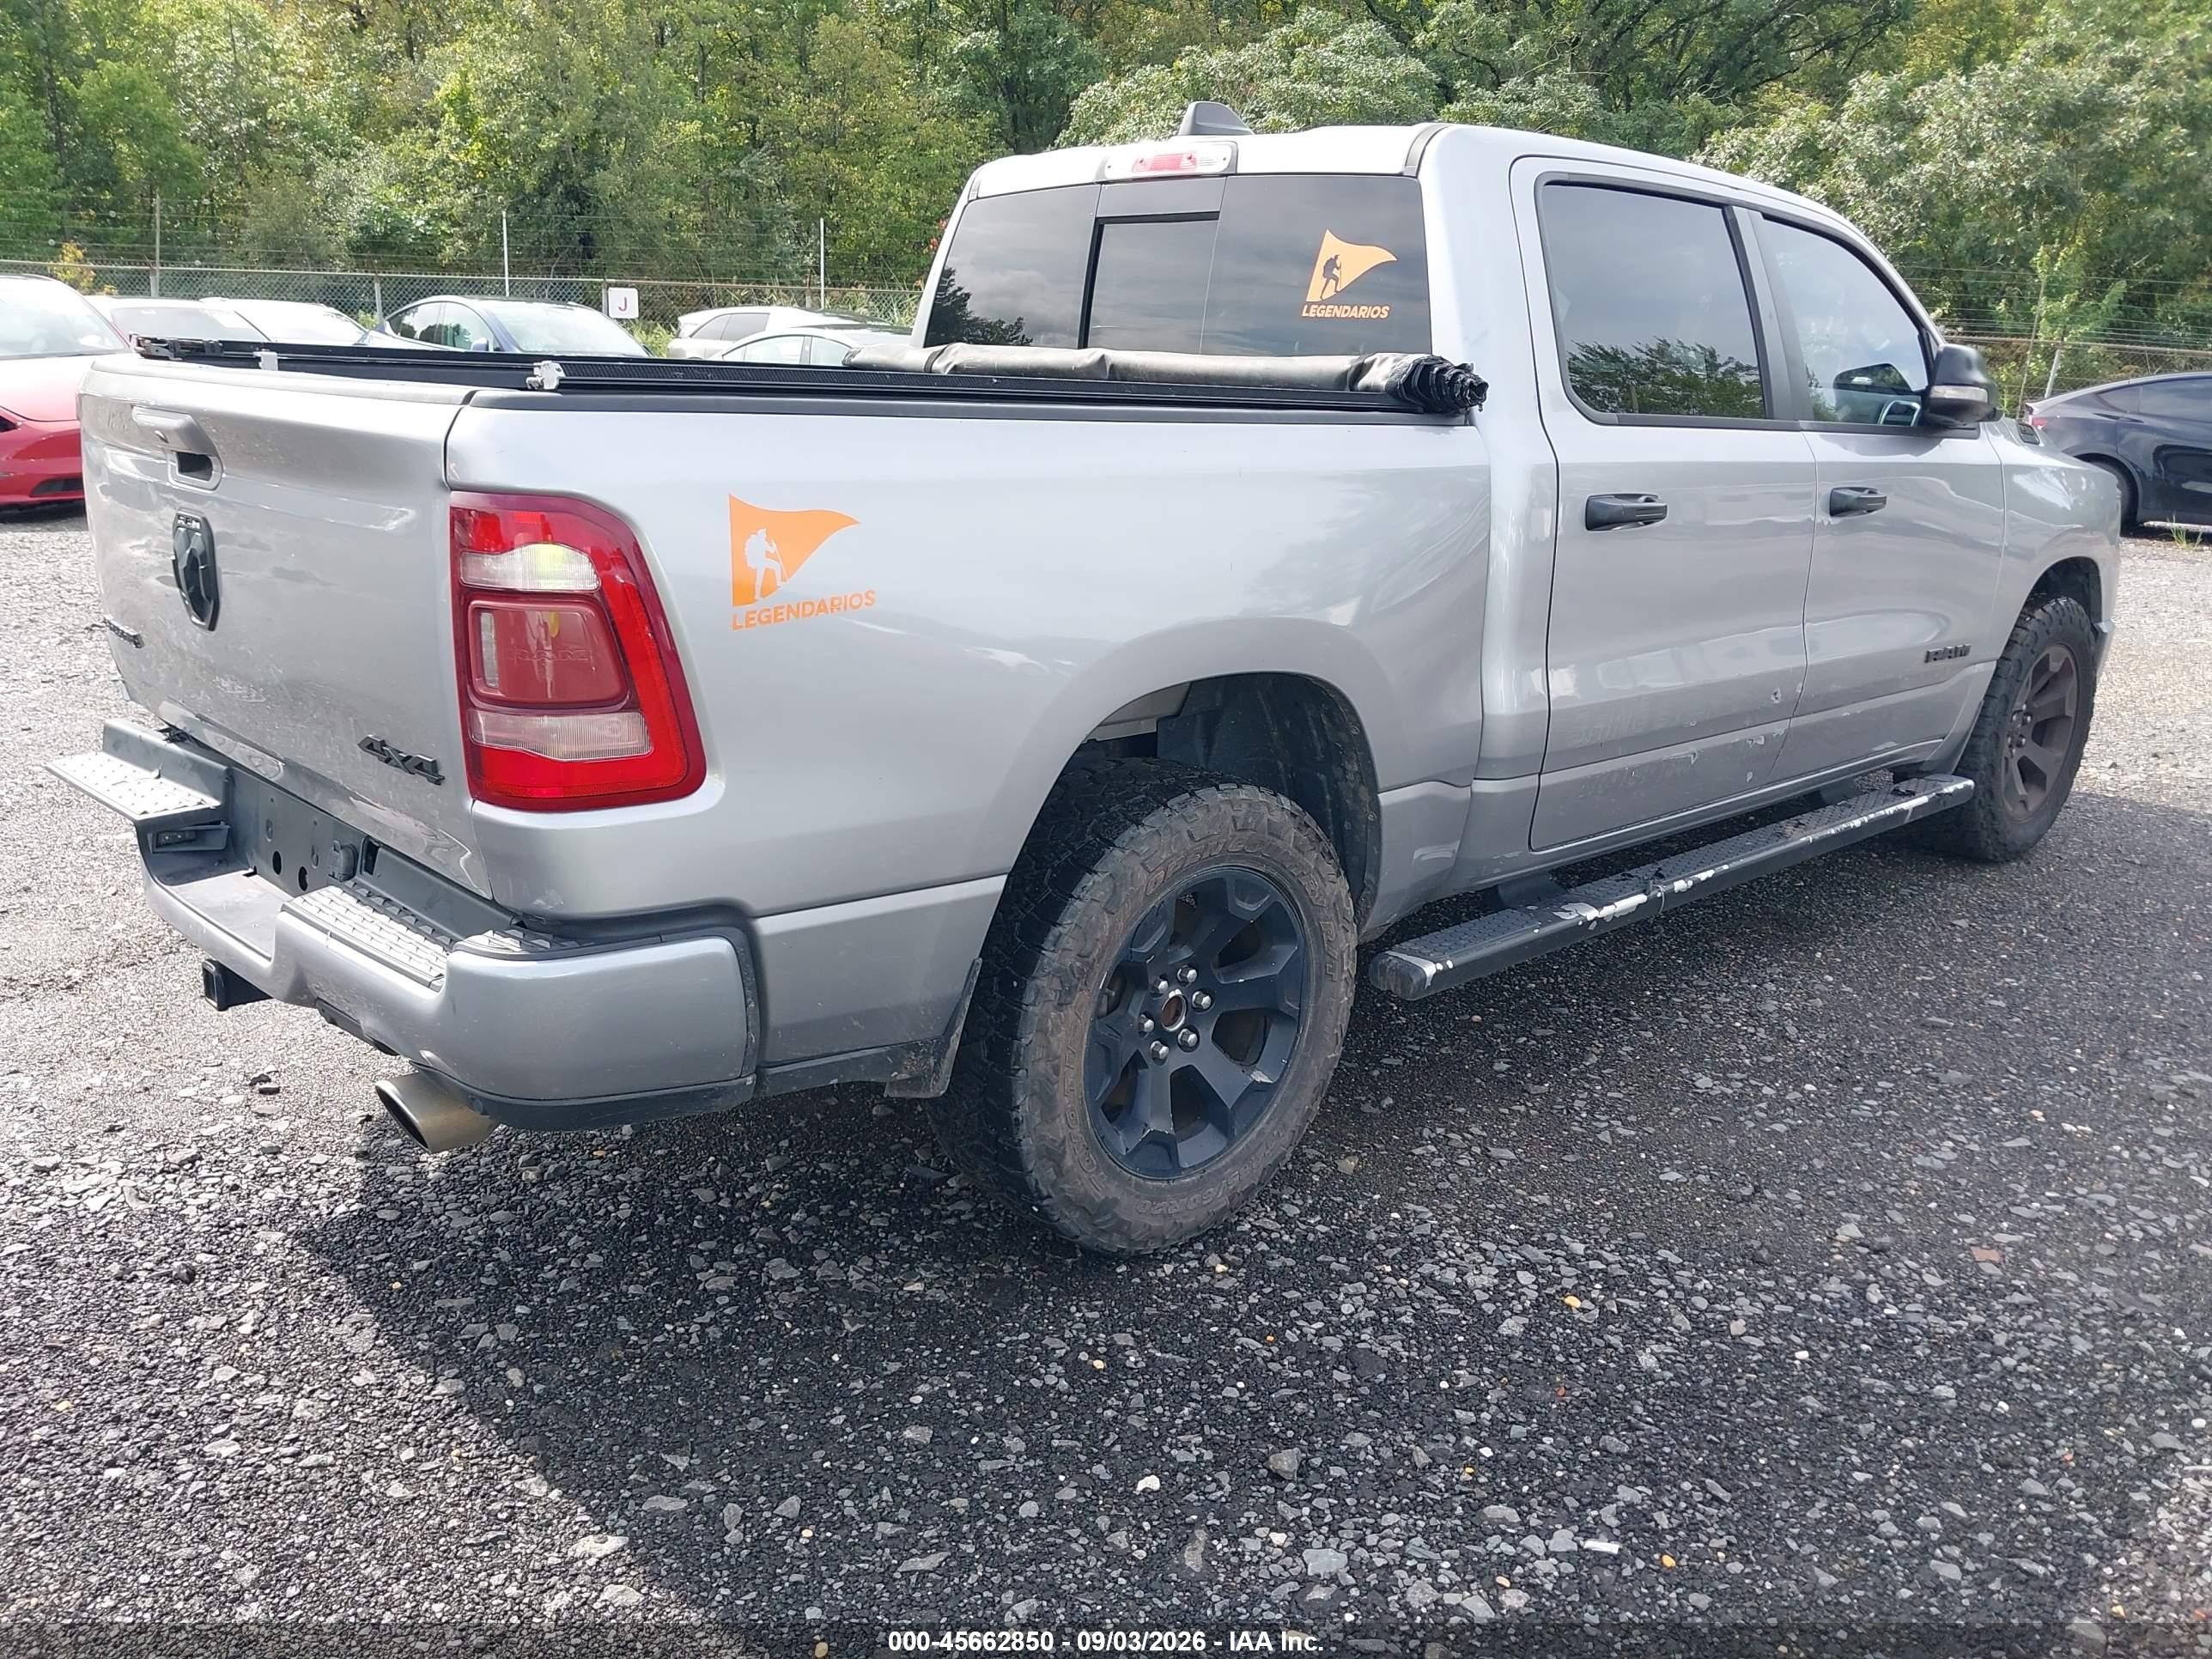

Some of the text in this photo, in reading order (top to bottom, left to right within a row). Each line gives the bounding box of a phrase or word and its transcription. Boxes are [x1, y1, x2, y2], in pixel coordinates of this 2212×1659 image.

[618, 296, 627, 312] J
[1302, 304, 1390, 319] LEGENDARIOS
[732, 589, 876, 631] LEGENDARIOS
[1924, 644, 1972, 663] RAM
[1145, 840, 1226, 896] OPEN
[1063, 1104, 1107, 1192] TOYO
